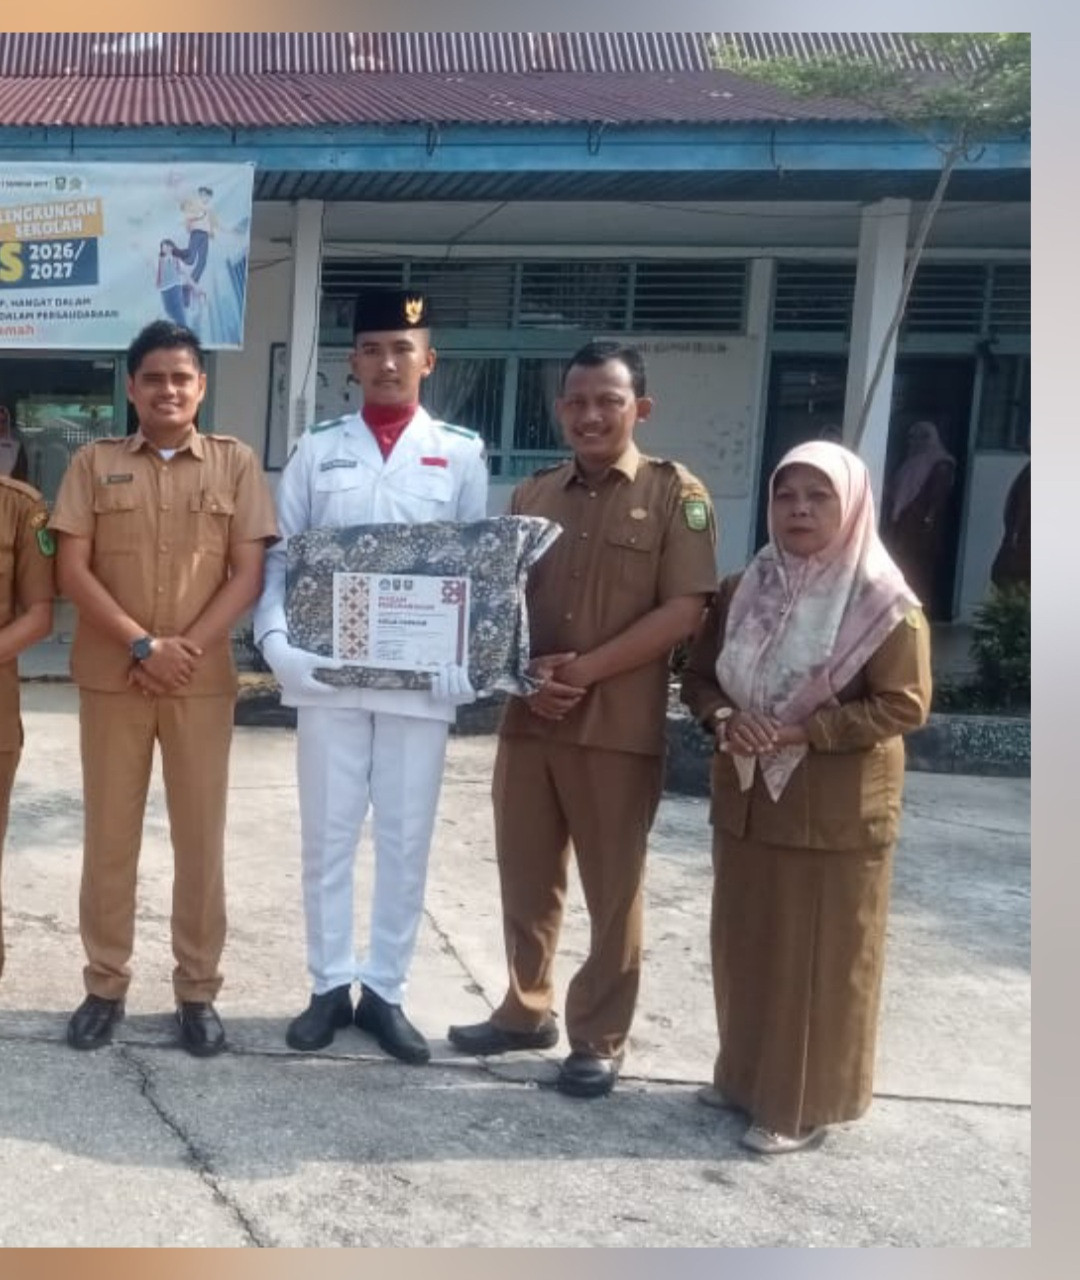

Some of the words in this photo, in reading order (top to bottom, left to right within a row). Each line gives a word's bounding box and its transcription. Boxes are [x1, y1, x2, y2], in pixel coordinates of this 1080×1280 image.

[15, 218, 82, 238] SEKOLAH
[29, 241, 86, 261] 2026/
[30, 262, 74, 280] 2027
[55, 296, 92, 307] DALAM
[0, 311, 34, 321] DALAM
